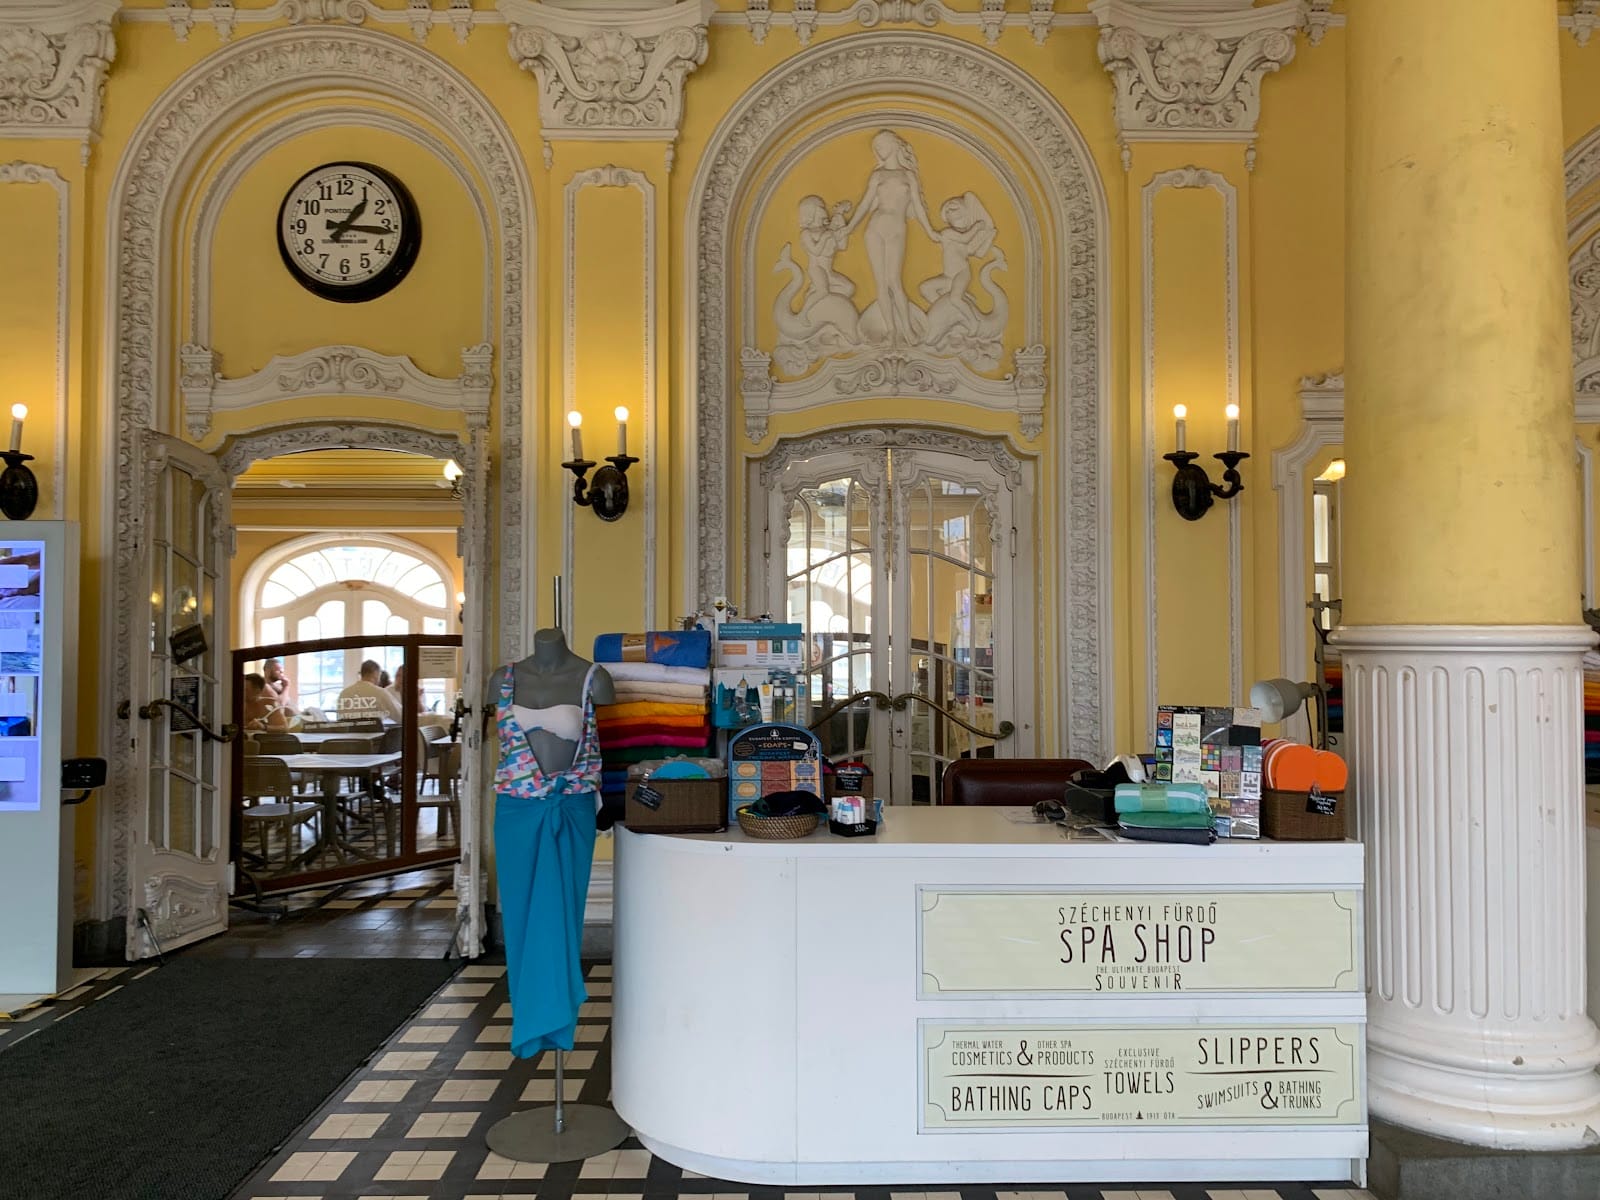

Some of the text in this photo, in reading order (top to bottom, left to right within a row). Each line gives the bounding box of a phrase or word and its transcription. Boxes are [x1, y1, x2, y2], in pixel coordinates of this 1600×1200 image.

[320, 185, 332, 200] 11
[336, 180, 353, 195] 12
[361, 187, 368, 200] 1
[304, 200, 320, 215] 10
[374, 200, 385, 215] 2
[296, 219, 306, 234] 9
[381, 219, 392, 233] 3
[304, 239, 314, 254] 8
[374, 239, 386, 254] 4
[319, 254, 330, 268] 7
[340, 259, 350, 274] 6
[360, 254, 370, 268] 5
[1058, 902, 1218, 925] SZÉCHENYI FÜRDŐ
[1060, 924, 1215, 963] SPA SHOP
[1095, 974, 1182, 990] SOUVENIR
[952, 1041, 1003, 1049] THERMAL WATER
[1038, 1041, 1057, 1049] OTHER
[1119, 1048, 1160, 1057] EXCLUSIVE
[1198, 1037, 1320, 1064] SLIPPERS
[952, 1040, 1094, 1066] COSMETICS & PRODUCTS
[1104, 1058, 1145, 1068] SZÉCHENYI
[1104, 1072, 1174, 1094] TOWELS
[1279, 1081, 1321, 1094] BATHING
[952, 1086, 1092, 1111] BATHING CAPS
[1197, 1081, 1279, 1109] SWIMSUITS &
[1283, 1096, 1321, 1109] TRUNKS
